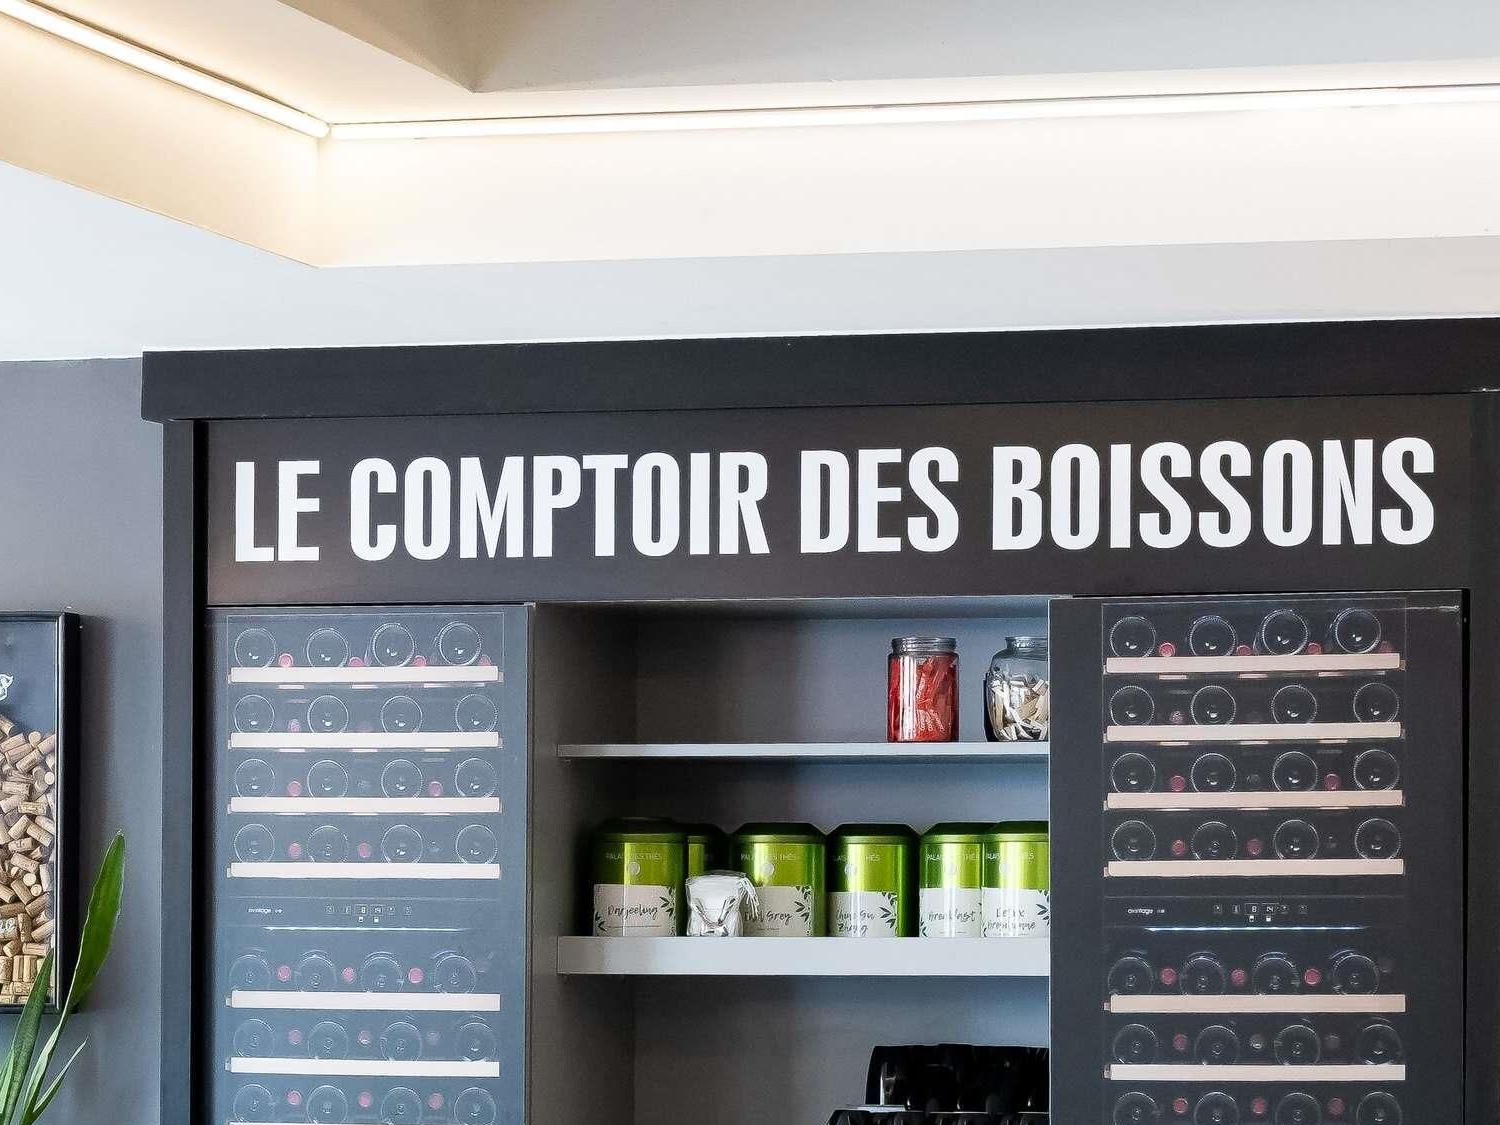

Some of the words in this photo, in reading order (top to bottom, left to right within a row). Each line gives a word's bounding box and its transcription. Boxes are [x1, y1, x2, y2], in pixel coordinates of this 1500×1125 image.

[235, 460, 320, 562] LE
[350, 452, 771, 561] COMPTOIR
[800, 447, 959, 554] DES
[993, 437, 1435, 550] BOISSONS
